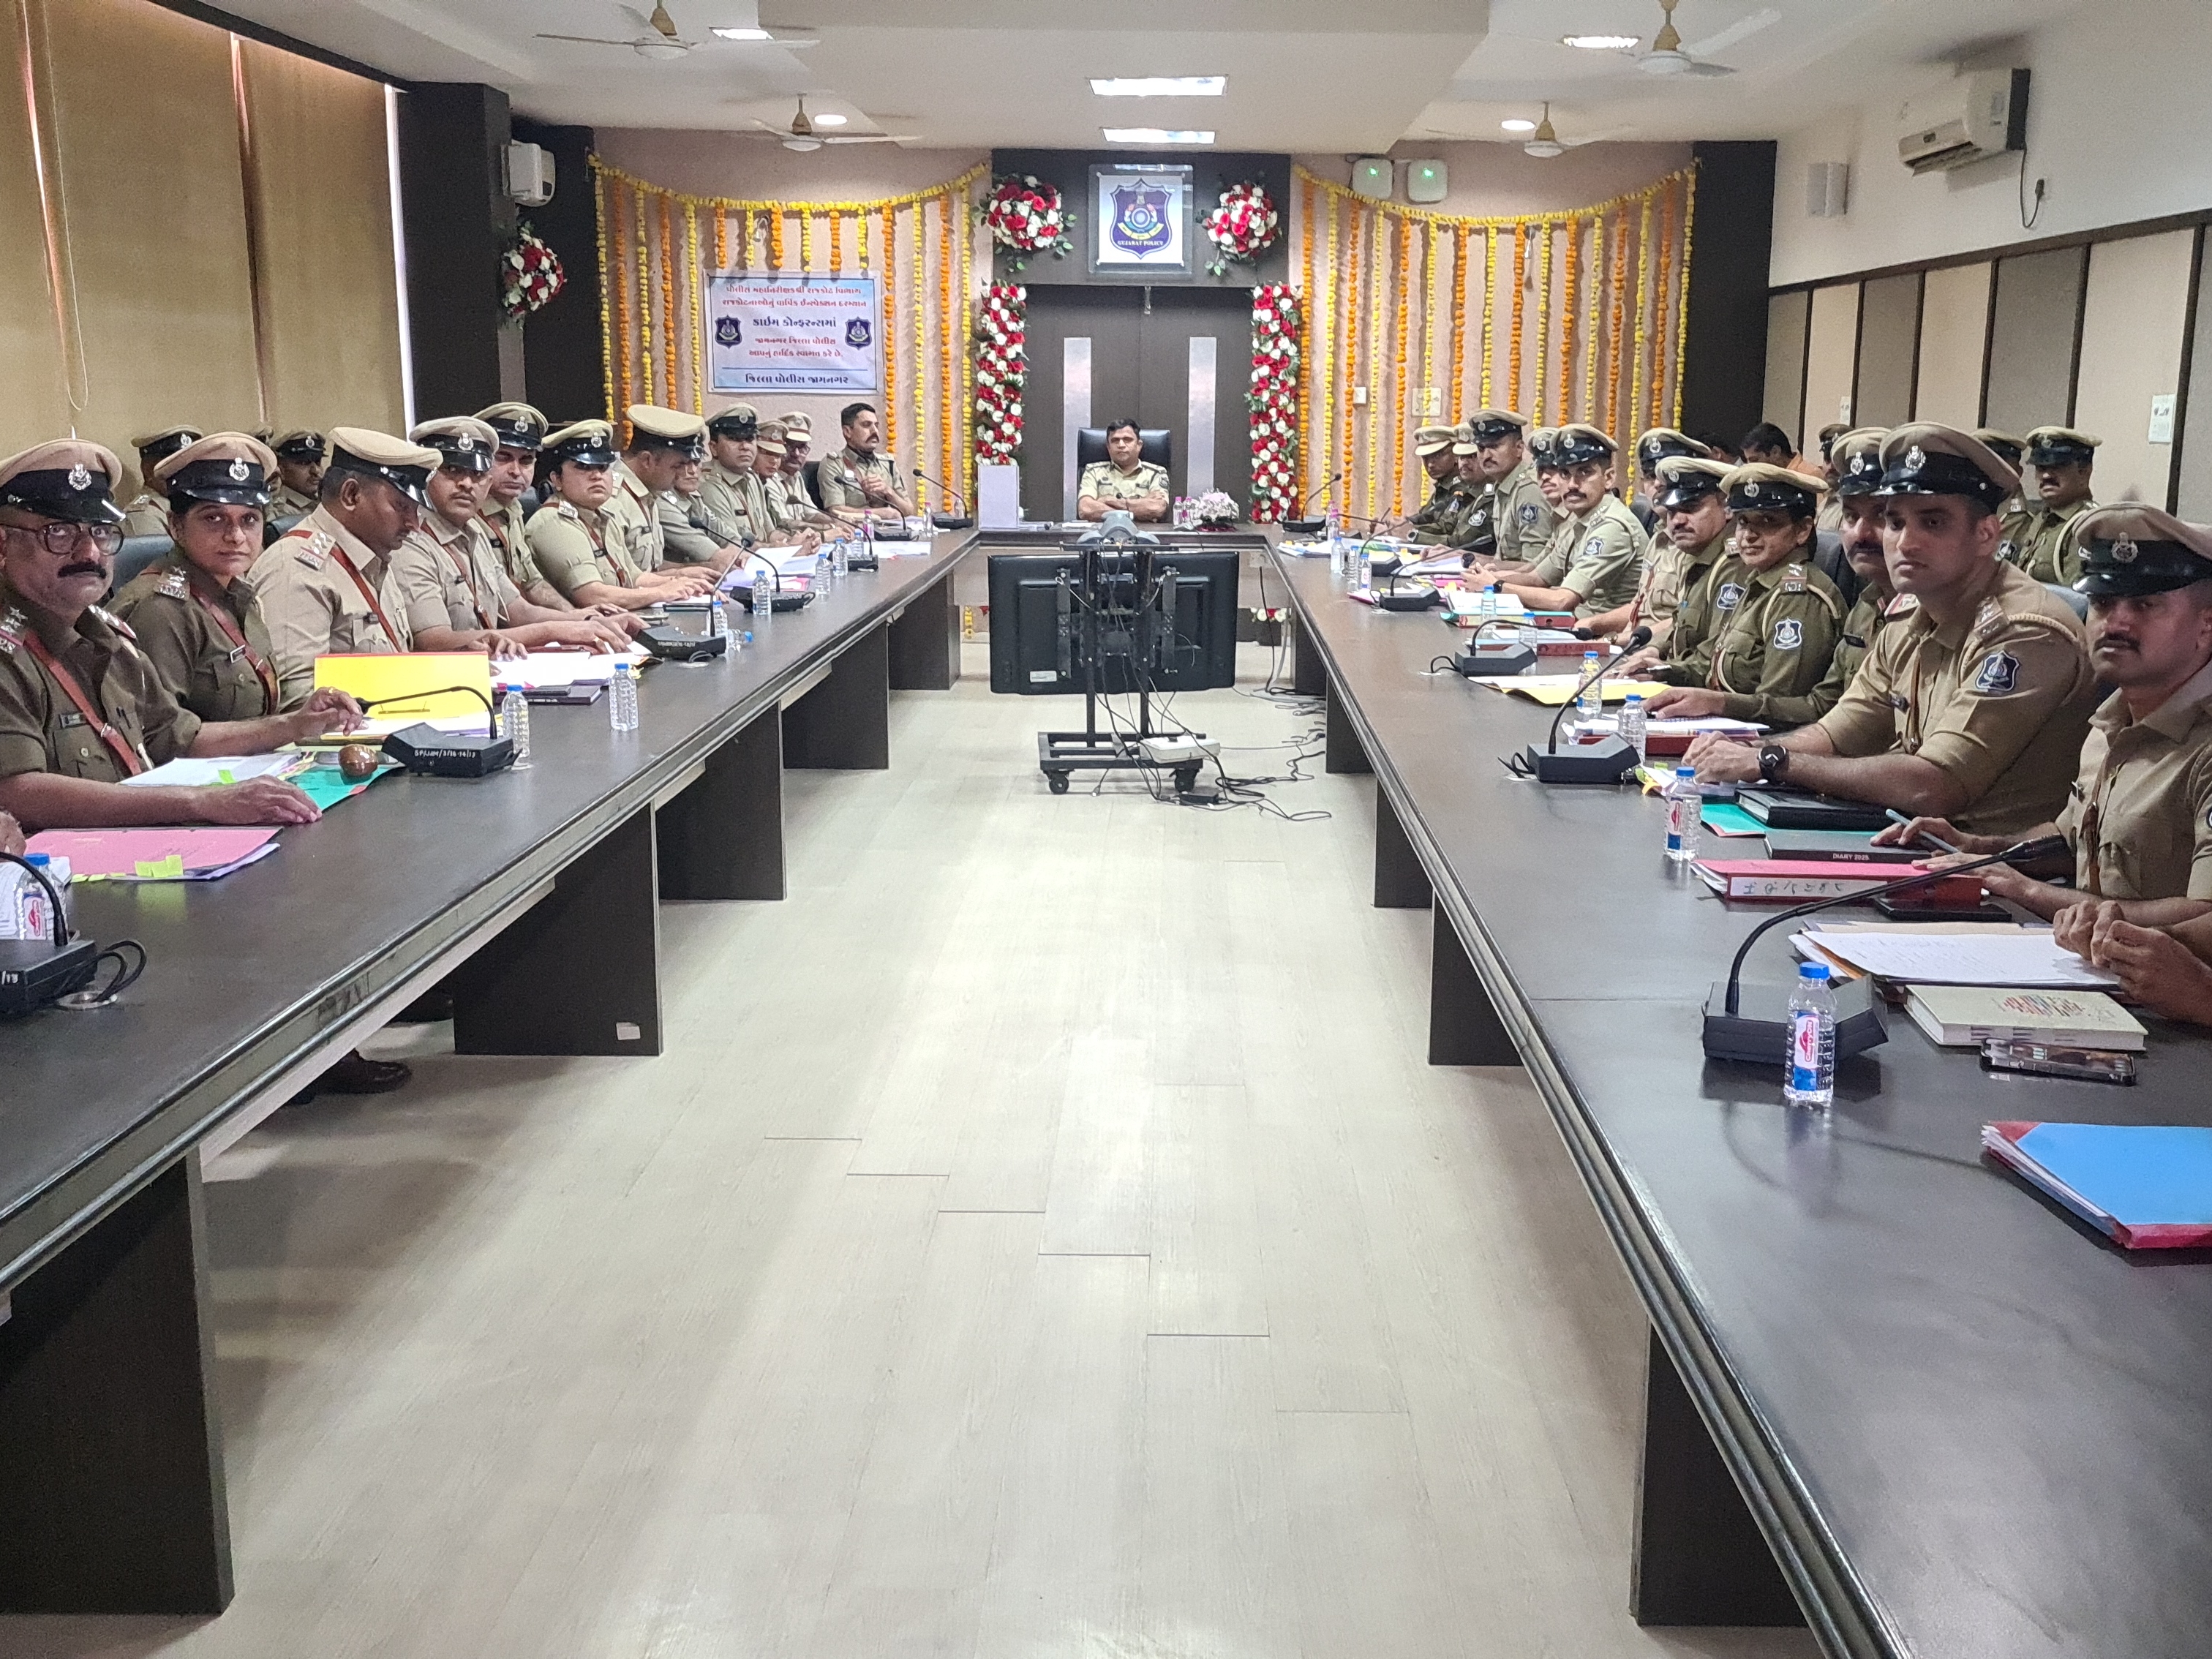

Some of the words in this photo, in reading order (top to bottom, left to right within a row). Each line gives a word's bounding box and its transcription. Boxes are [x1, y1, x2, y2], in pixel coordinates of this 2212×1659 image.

[812, 336, 836, 345] પોલીસ
[745, 372, 772, 383] જિલ્લા
[775, 372, 805, 383] પોલીસ
[808, 376, 849, 384] જામનગર
